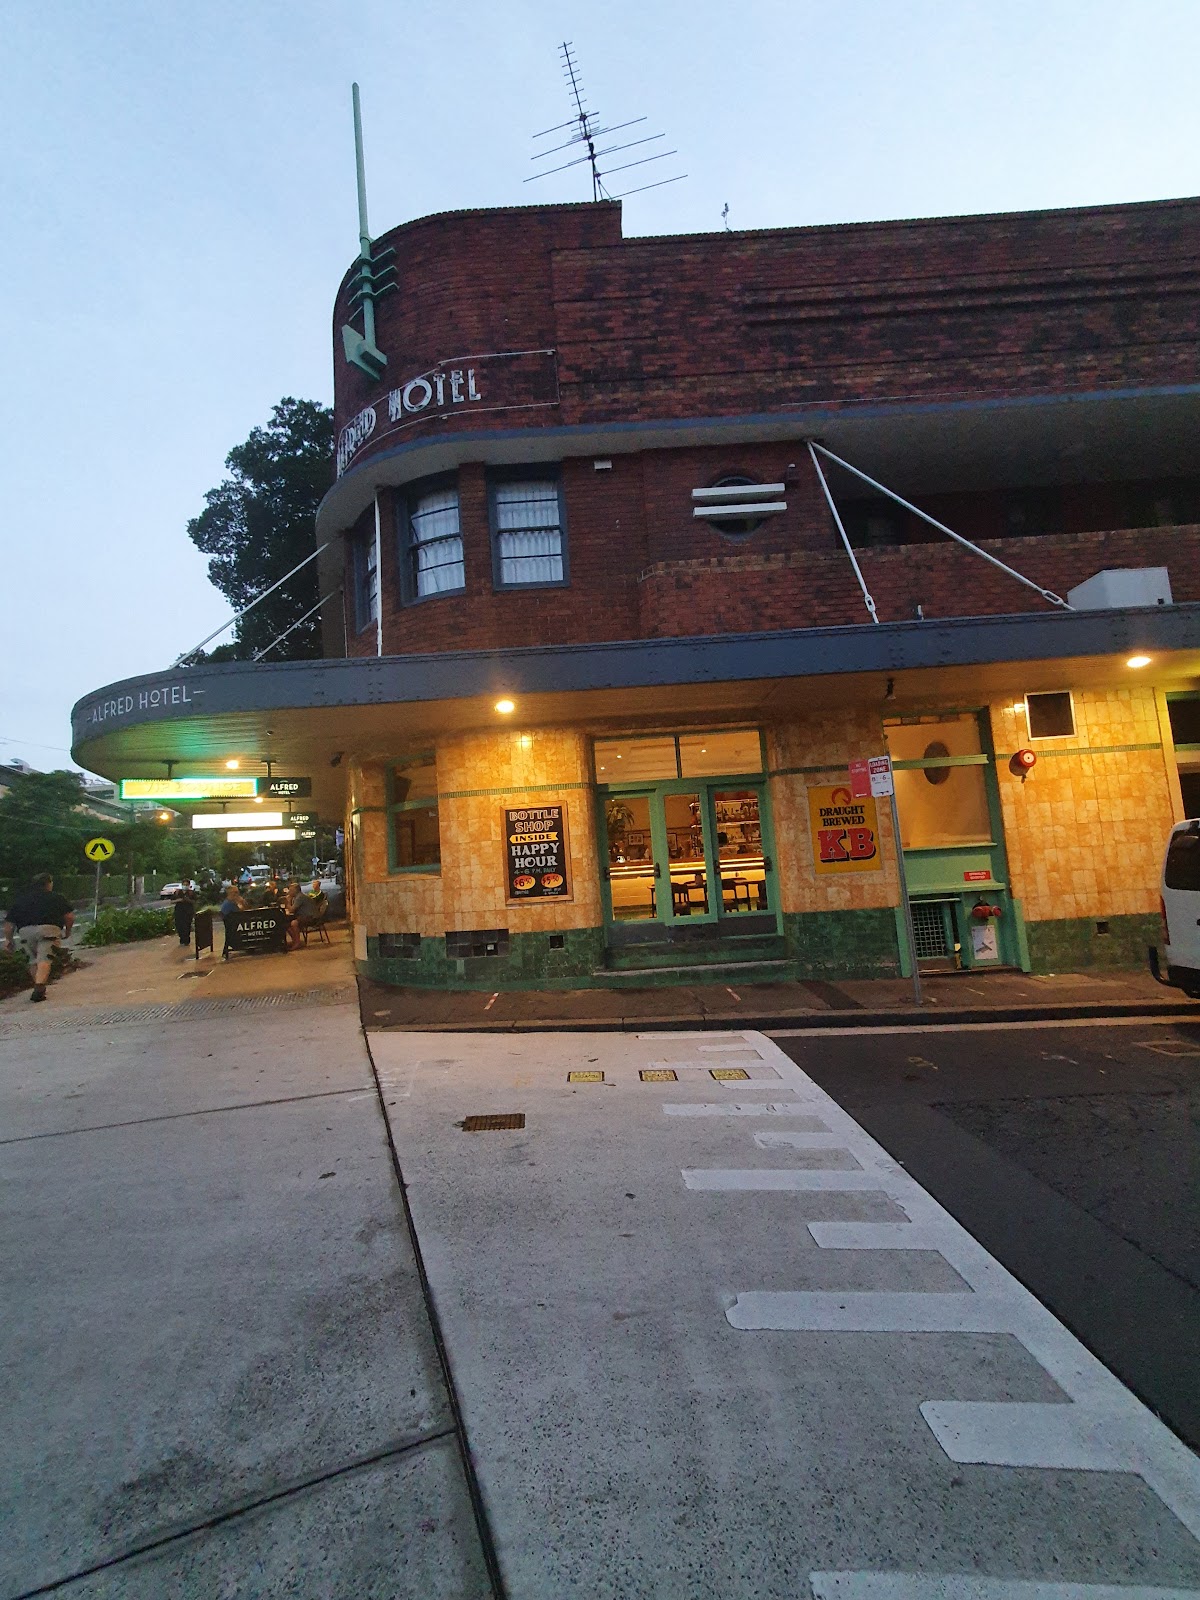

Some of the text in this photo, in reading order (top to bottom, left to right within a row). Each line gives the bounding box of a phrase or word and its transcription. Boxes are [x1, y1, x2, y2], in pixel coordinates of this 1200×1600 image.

[388, 368, 482, 423] HOTEL
[91, 685, 192, 724] ALFRED HOTEL
[872, 766, 888, 774] ZONE
[509, 809, 558, 821] BOTTLE
[819, 805, 865, 817] DRAUGHT
[515, 821, 553, 832] SHOP
[823, 816, 865, 827] BREWED
[515, 833, 552, 842] INSIDE
[511, 842, 560, 856] HAPPY
[817, 827, 877, 863] KB
[514, 855, 558, 869] HOUR
[237, 920, 276, 931] ALFRED
